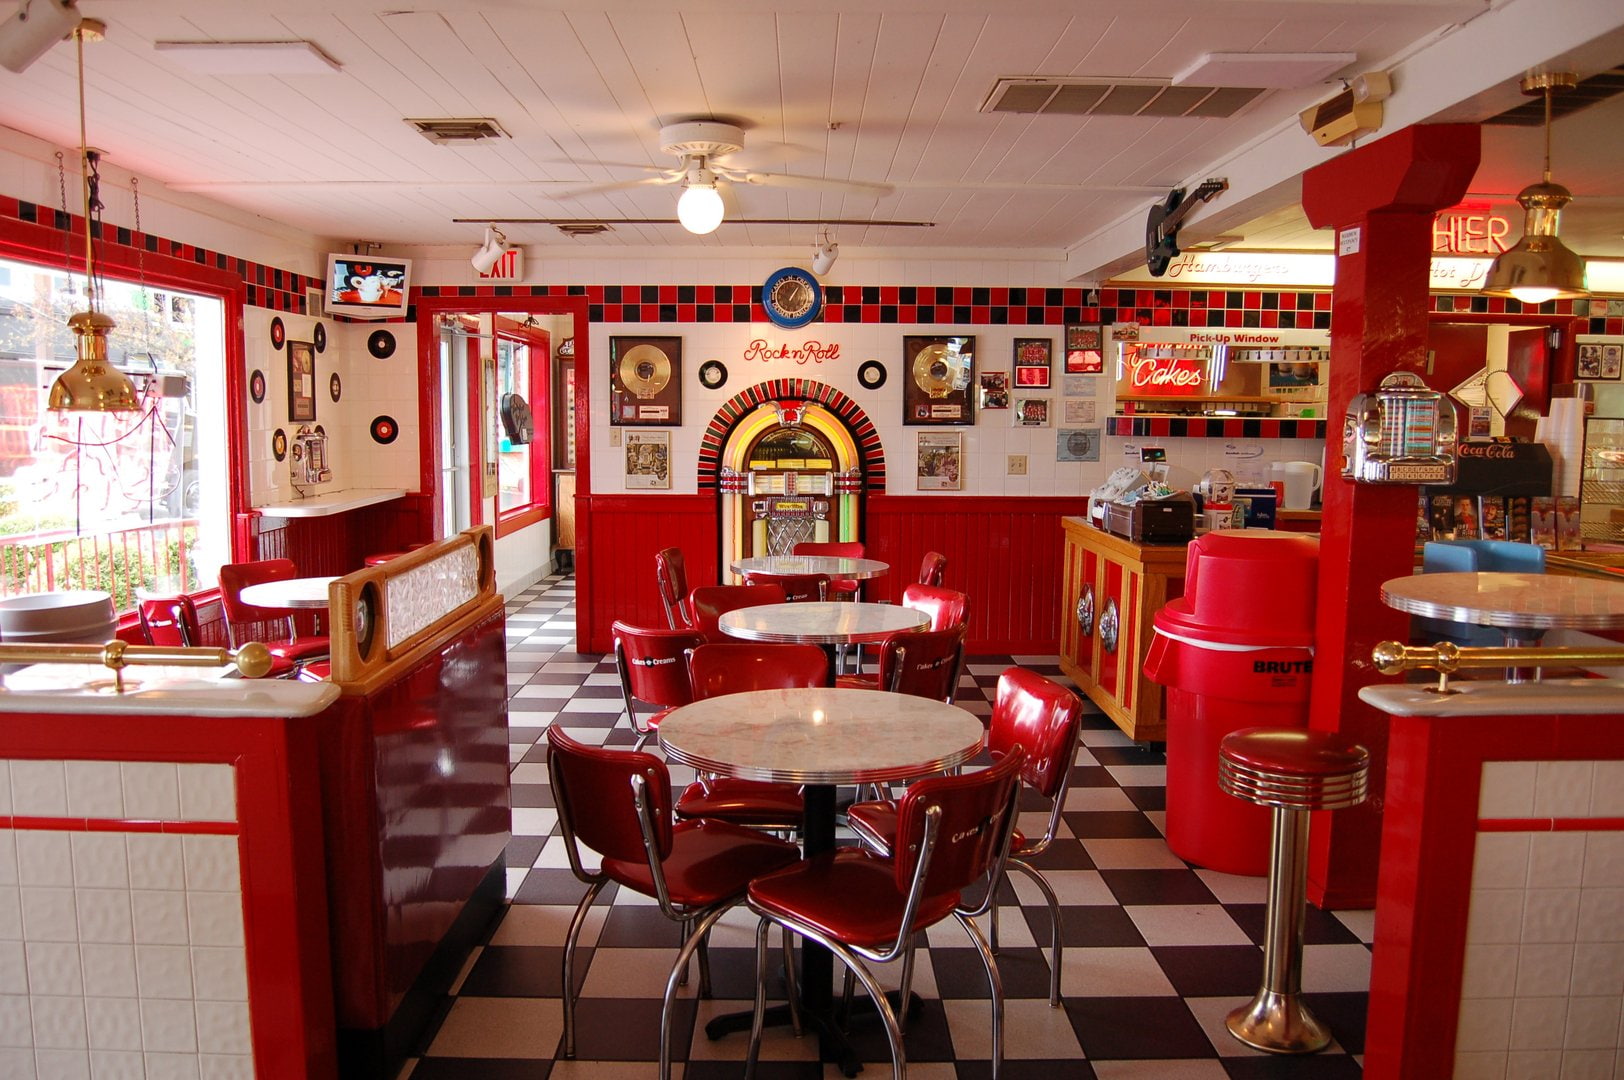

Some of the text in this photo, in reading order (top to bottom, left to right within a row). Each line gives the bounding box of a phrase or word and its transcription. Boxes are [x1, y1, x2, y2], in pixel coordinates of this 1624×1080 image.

[480, 250, 517, 278] XIT
[1168, 255, 1289, 282] Hamburgers
[1189, 333, 1279, 344] Pick-Up Window
[743, 339, 790, 363] Rock
[796, 340, 840, 365] Roll
[1134, 358, 1201, 387] Cakes
[1458, 444, 1515, 459] Coca-Cola
[1253, 660, 1313, 674] BRUTE
